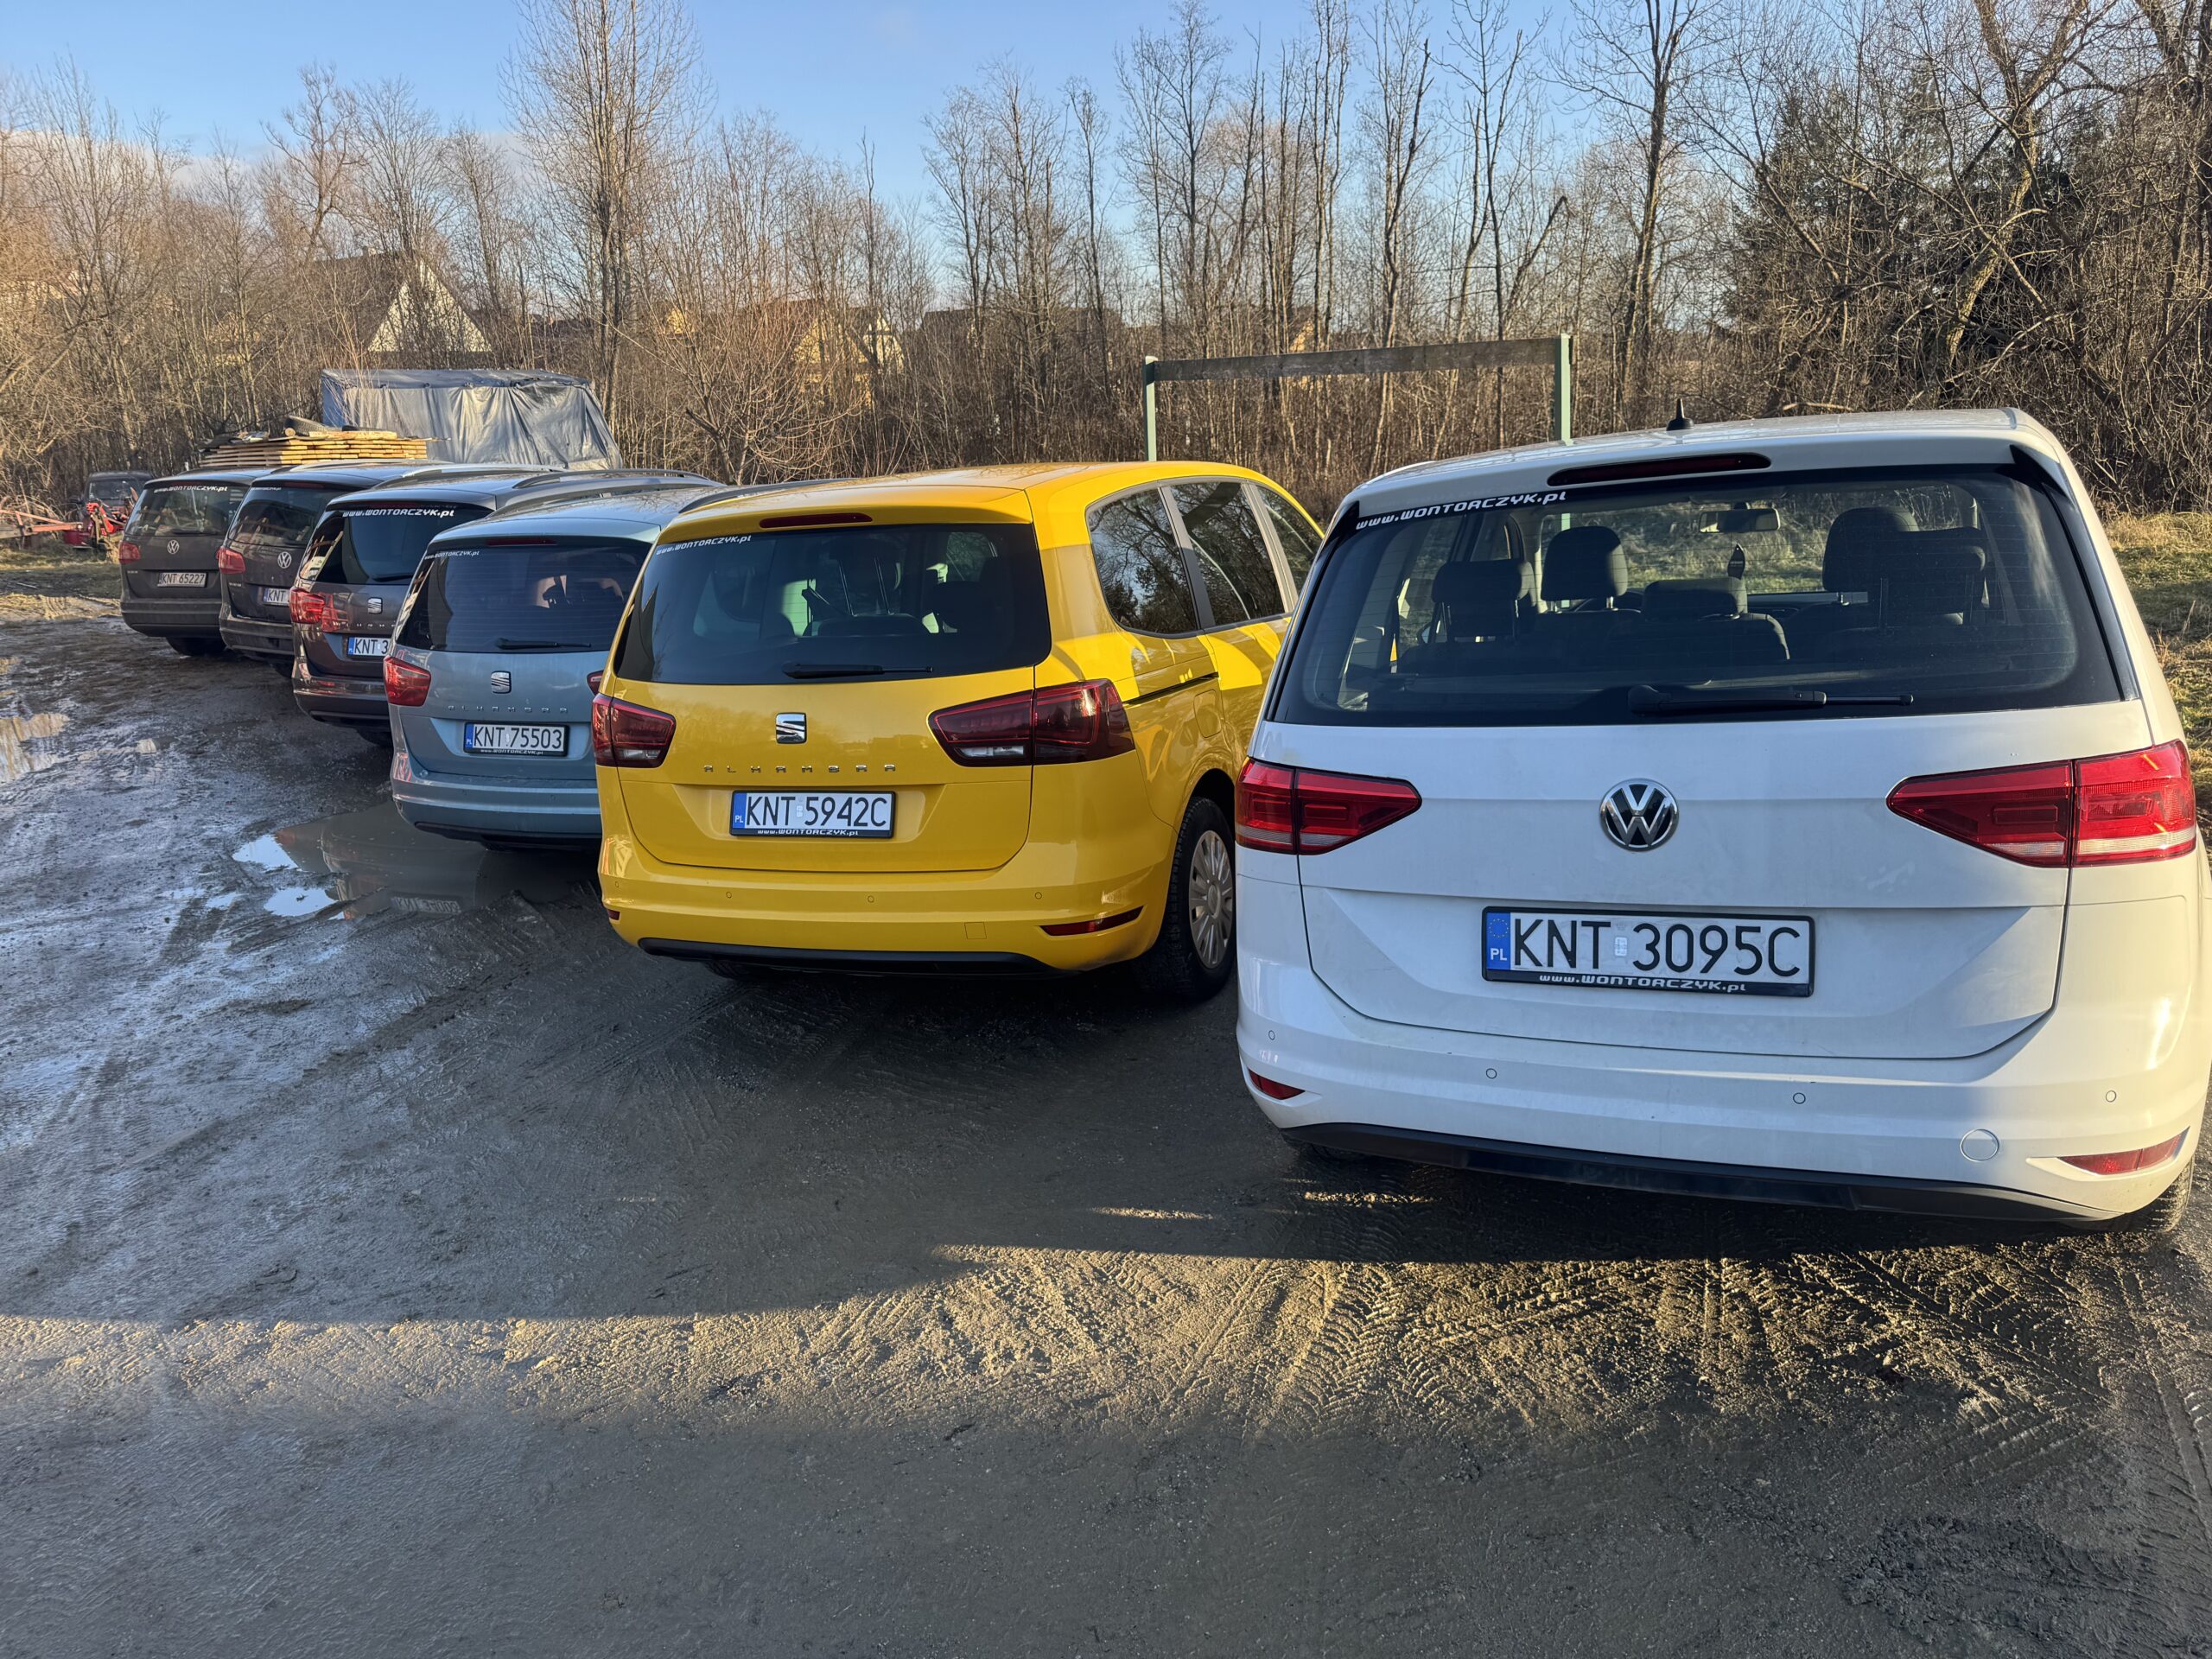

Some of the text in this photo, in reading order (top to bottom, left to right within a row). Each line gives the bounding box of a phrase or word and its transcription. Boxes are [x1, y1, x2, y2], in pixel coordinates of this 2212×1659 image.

[342, 508, 454, 518] www.WONTORCZYK.pl
[1356, 491, 1567, 530] www.WONTORCZYK.pl
[657, 535, 752, 555] www.WONTORCZYK.pl
[162, 573, 205, 584] KNT 65227
[268, 589, 286, 601] KNT
[355, 639, 378, 654] KNT
[474, 726, 505, 747] KNT
[509, 727, 563, 749] 75503
[734, 796, 887, 827] PL KNT 5942C
[757, 829, 859, 837] www.WONTORCZYK.pl
[1490, 918, 1801, 978] PL KNT 3095C
[1539, 974, 1746, 994] www.WONTORCZYK.pl
